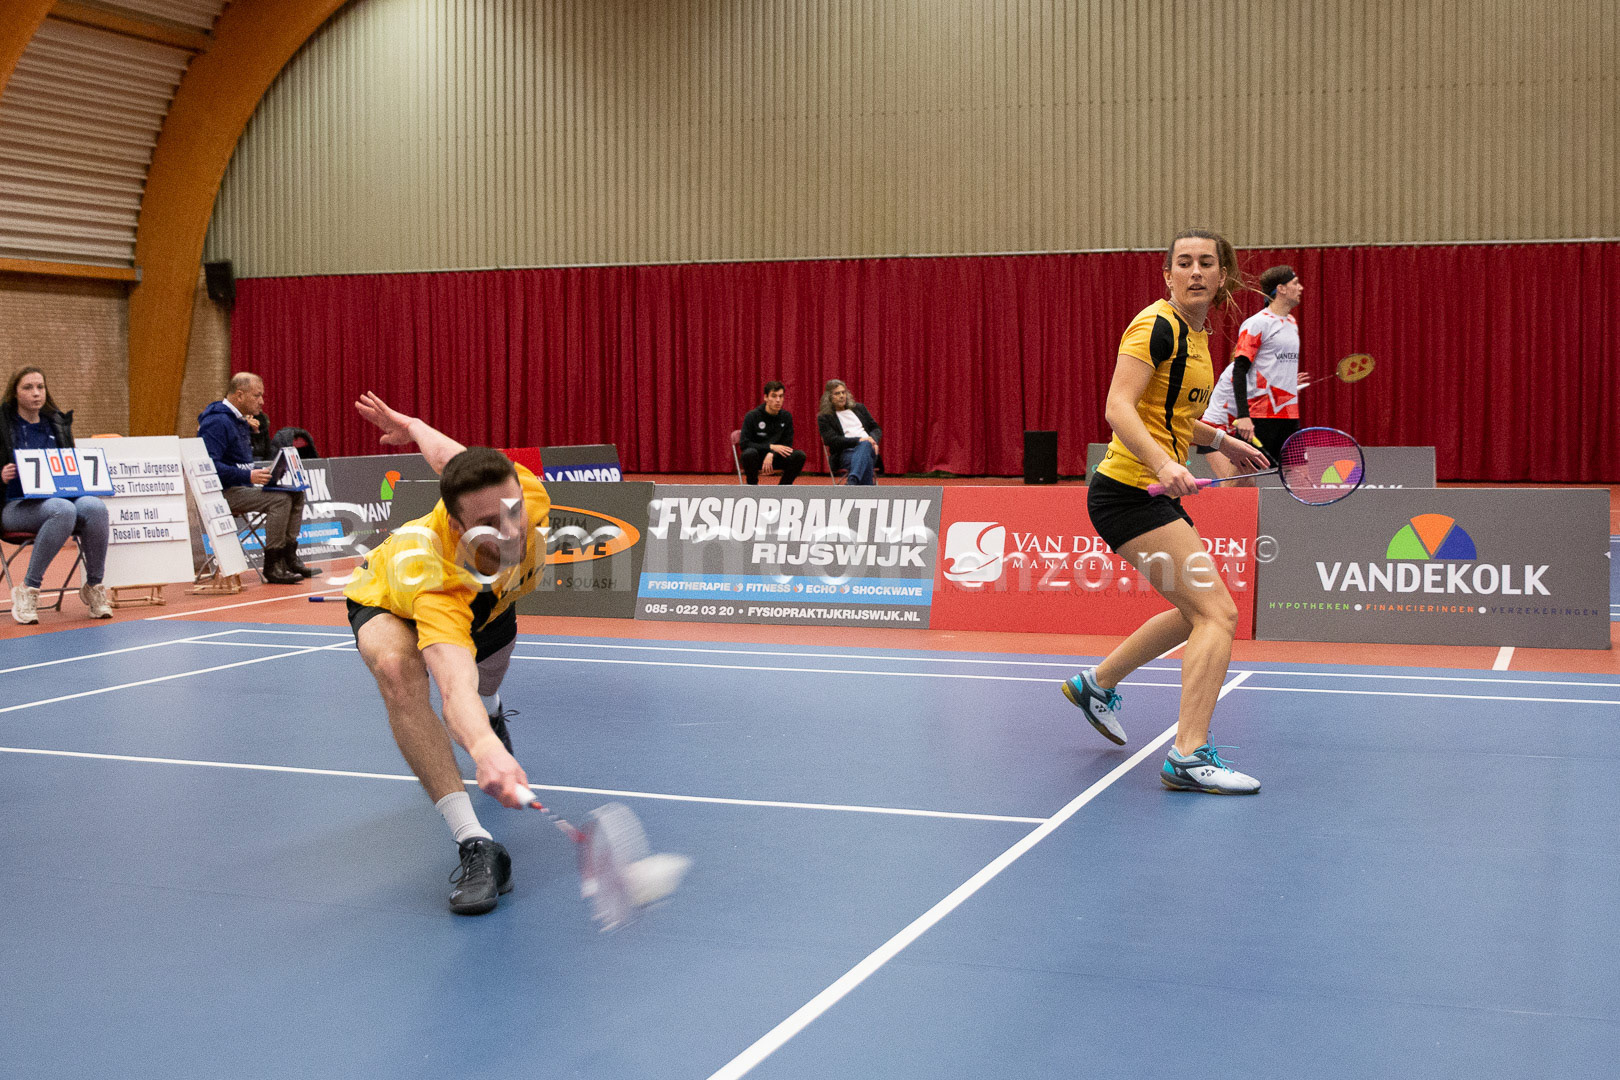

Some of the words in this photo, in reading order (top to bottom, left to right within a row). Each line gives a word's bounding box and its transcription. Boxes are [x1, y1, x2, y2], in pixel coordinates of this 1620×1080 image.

[25, 458, 40, 489] 7
[50, 455, 61, 473] 0
[65, 455, 76, 472] 0
[84, 455, 98, 486] 7
[143, 461, 179, 475] Jörgensen
[120, 509, 140, 521] Adam
[143, 508, 159, 520] Hall
[658, 496, 931, 544] FYSIOPRAKTIJK
[112, 528, 141, 540] Rosalie
[143, 527, 170, 539] Teuben
[1011, 532, 1064, 553] VAN
[752, 543, 926, 567] RIJSWIJK
[565, 577, 617, 589] SQUASH
[1316, 561, 1551, 596] VANDEKOLK
[648, 580, 730, 591] FYSIOTHERAPIE
[746, 583, 790, 593] FITNESS
[805, 584, 837, 594] ECHO
[852, 586, 922, 597] SHOCKWAVE
[644, 603, 668, 614] 085
[675, 604, 698, 615] 022
[701, 605, 716, 616] 03
[718, 606, 735, 616] 20
[747, 606, 921, 622] FYSIOPRAKTIJKRIJSWIJK.NL
[1269, 602, 1350, 610] HYPOTHEKEN
[1365, 604, 1474, 613] FINANCIERINGEN
[1491, 606, 1599, 616] VERZEKERINGEN
